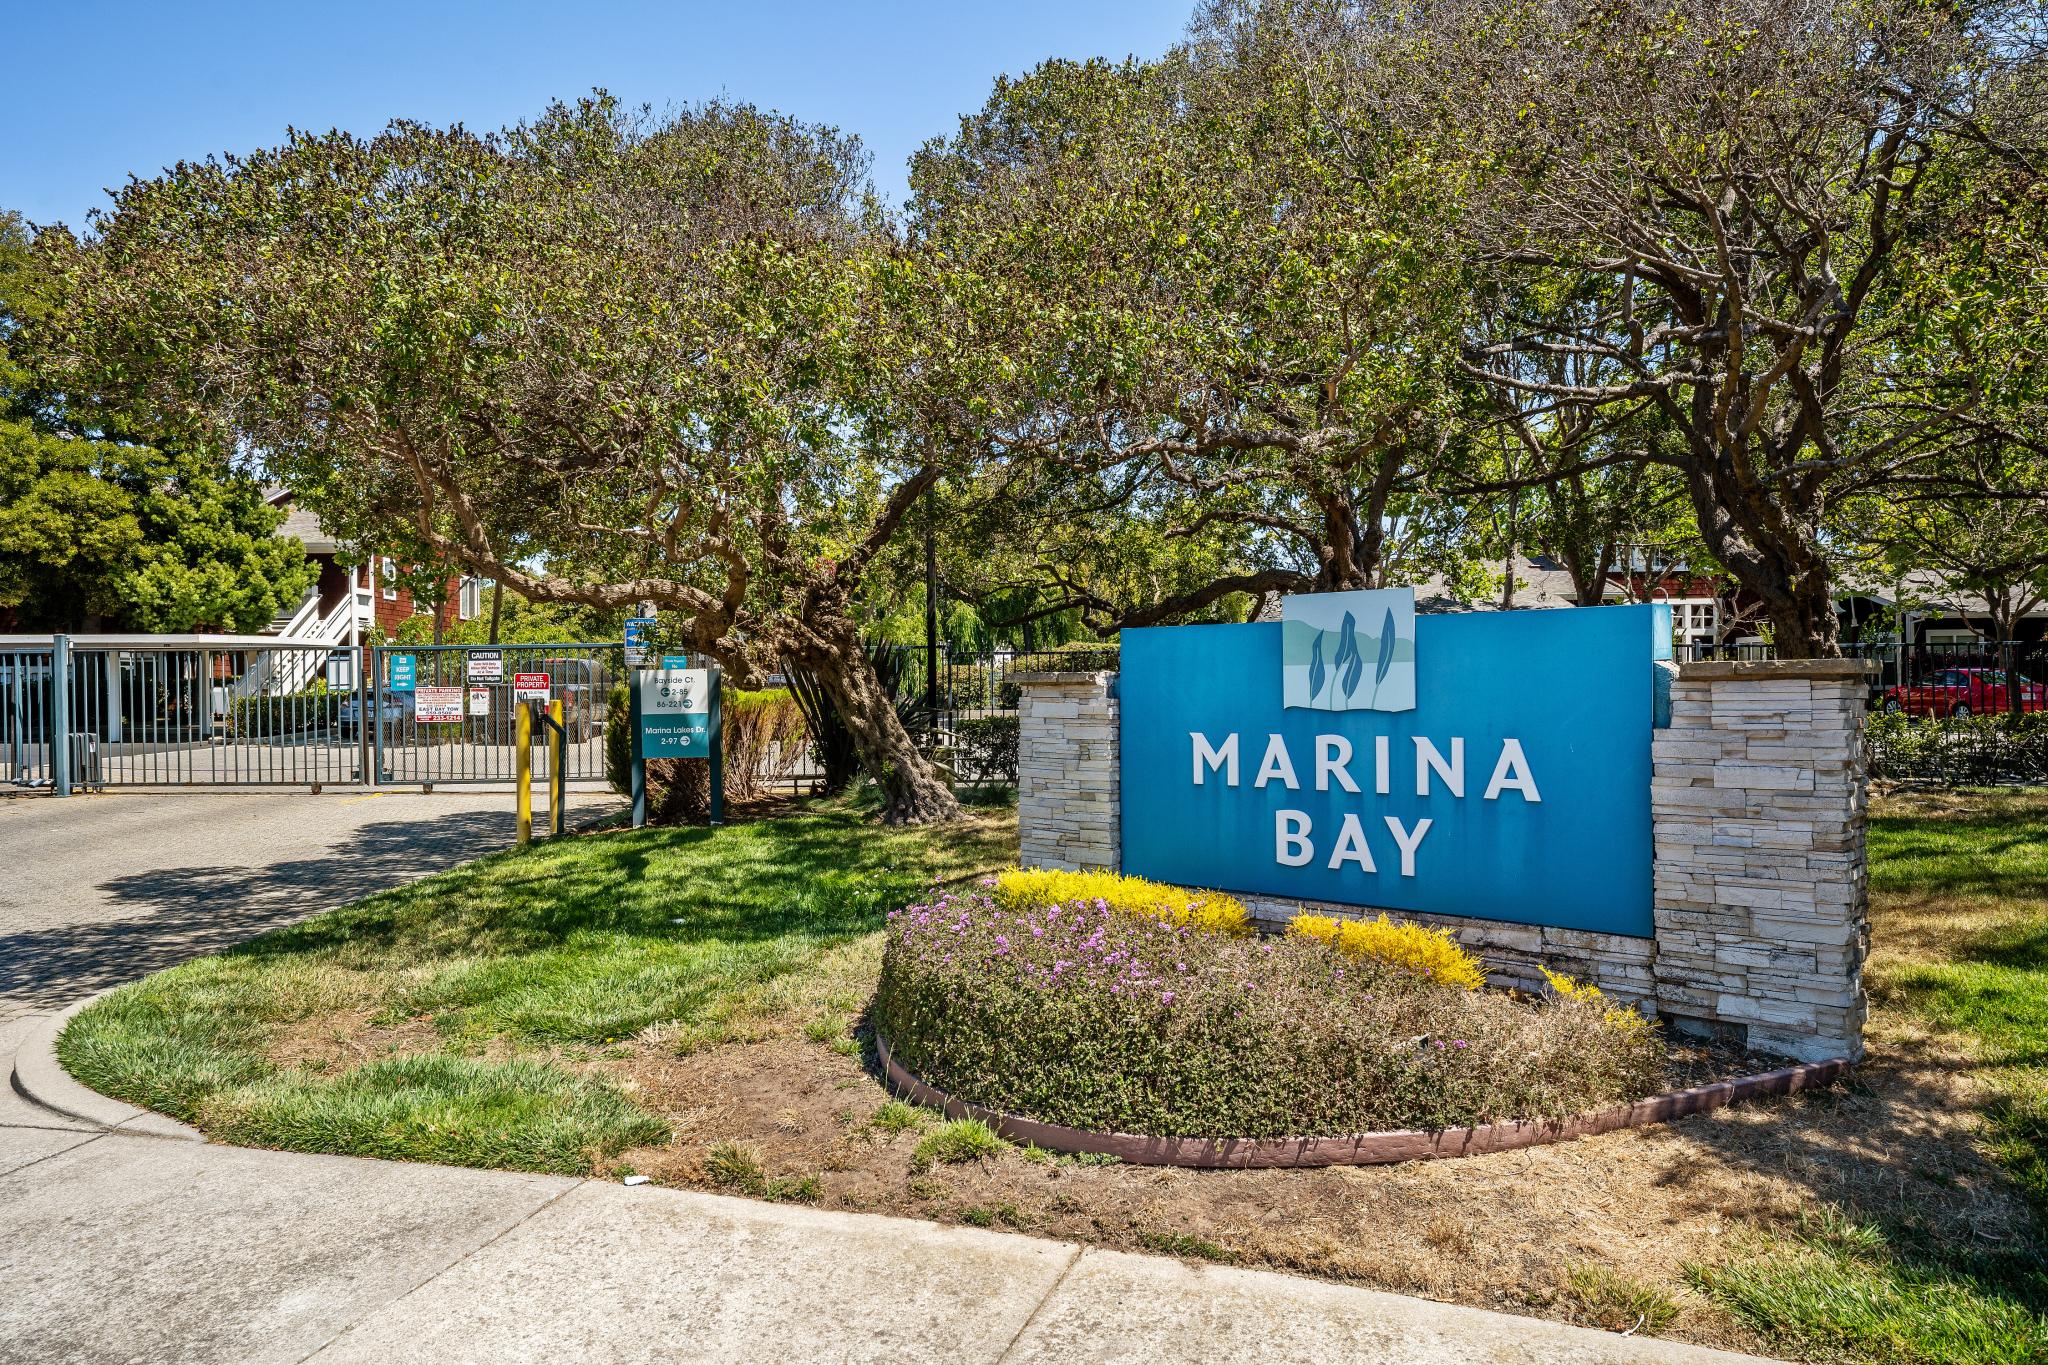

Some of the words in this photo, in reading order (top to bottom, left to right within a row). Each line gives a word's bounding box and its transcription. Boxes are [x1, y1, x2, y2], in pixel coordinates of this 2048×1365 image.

[517, 691, 528, 702] NO
[1189, 732, 1542, 802] MARINA
[1275, 809, 1433, 877] BAY
